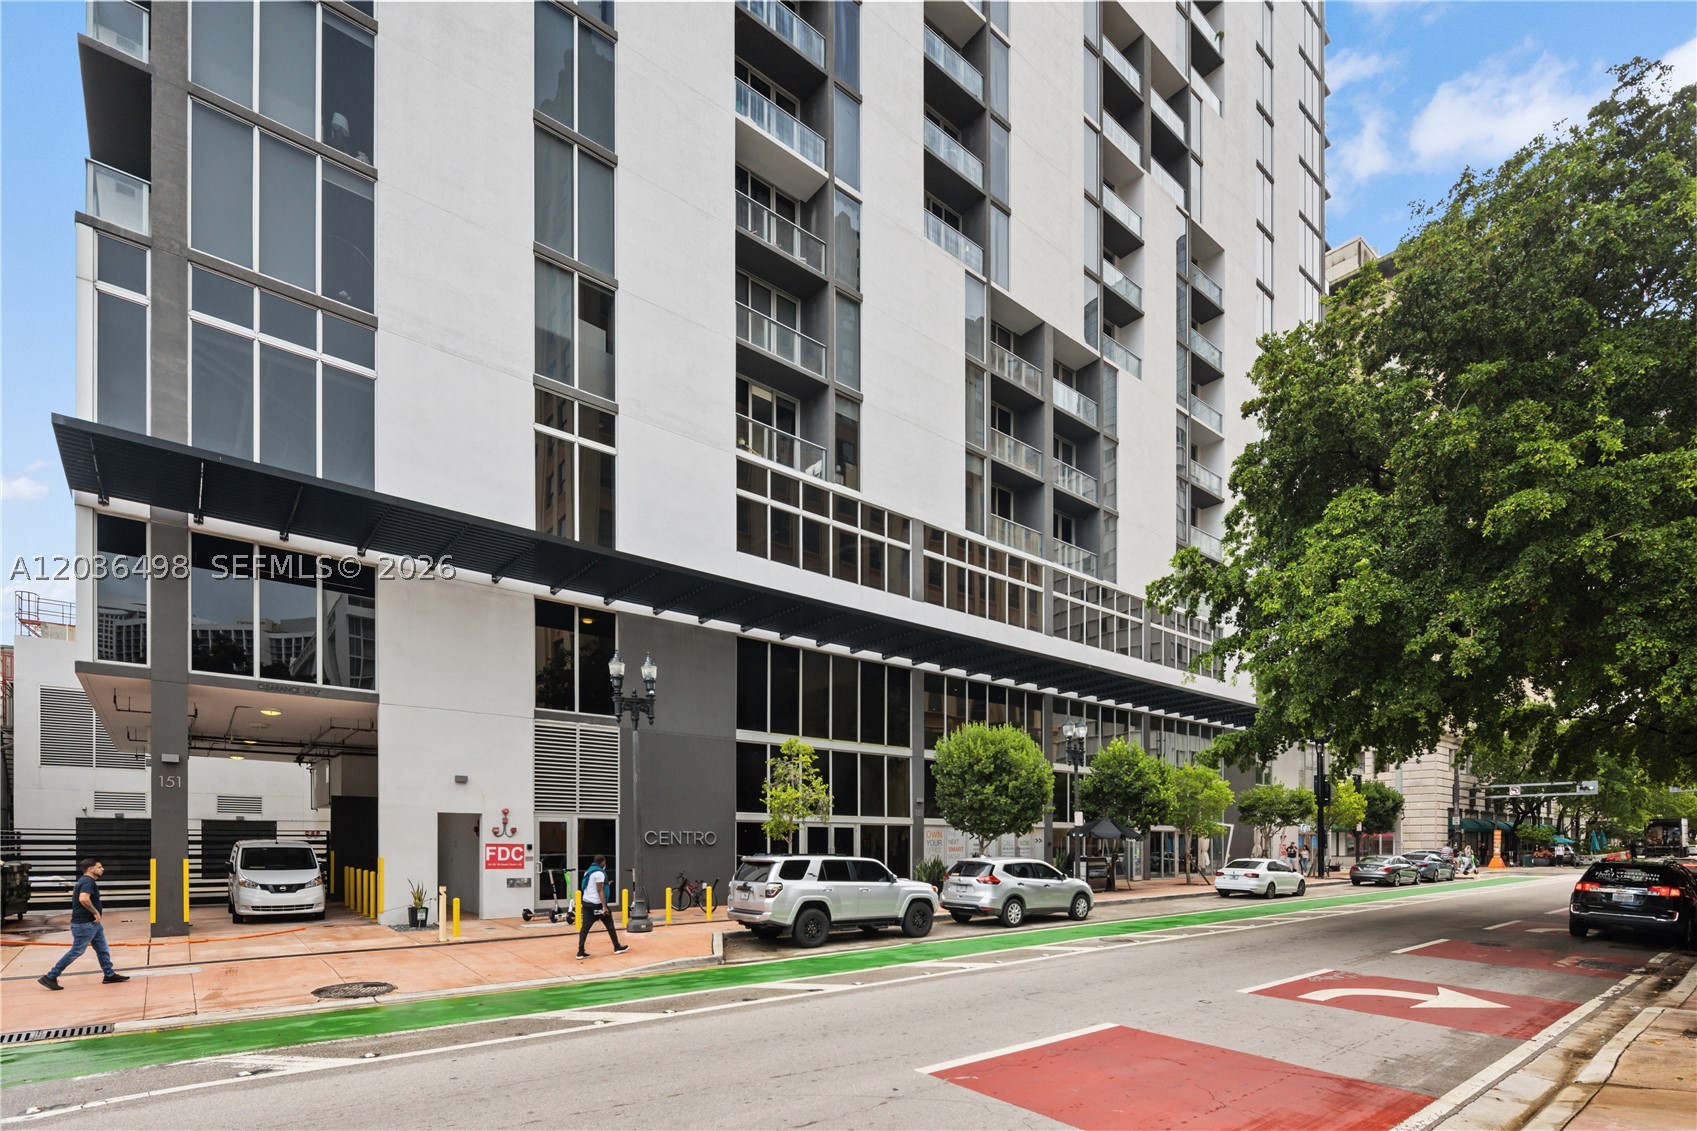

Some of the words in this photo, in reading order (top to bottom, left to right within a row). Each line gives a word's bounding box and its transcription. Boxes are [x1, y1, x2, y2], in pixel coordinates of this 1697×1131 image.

[257, 683, 299, 694] CLEARANCE
[158, 775, 181, 788] 151
[644, 830, 717, 845] CENTRO
[926, 830, 942, 839] OWN
[926, 839, 942, 847] YOUR
[486, 846, 524, 861] FDC
